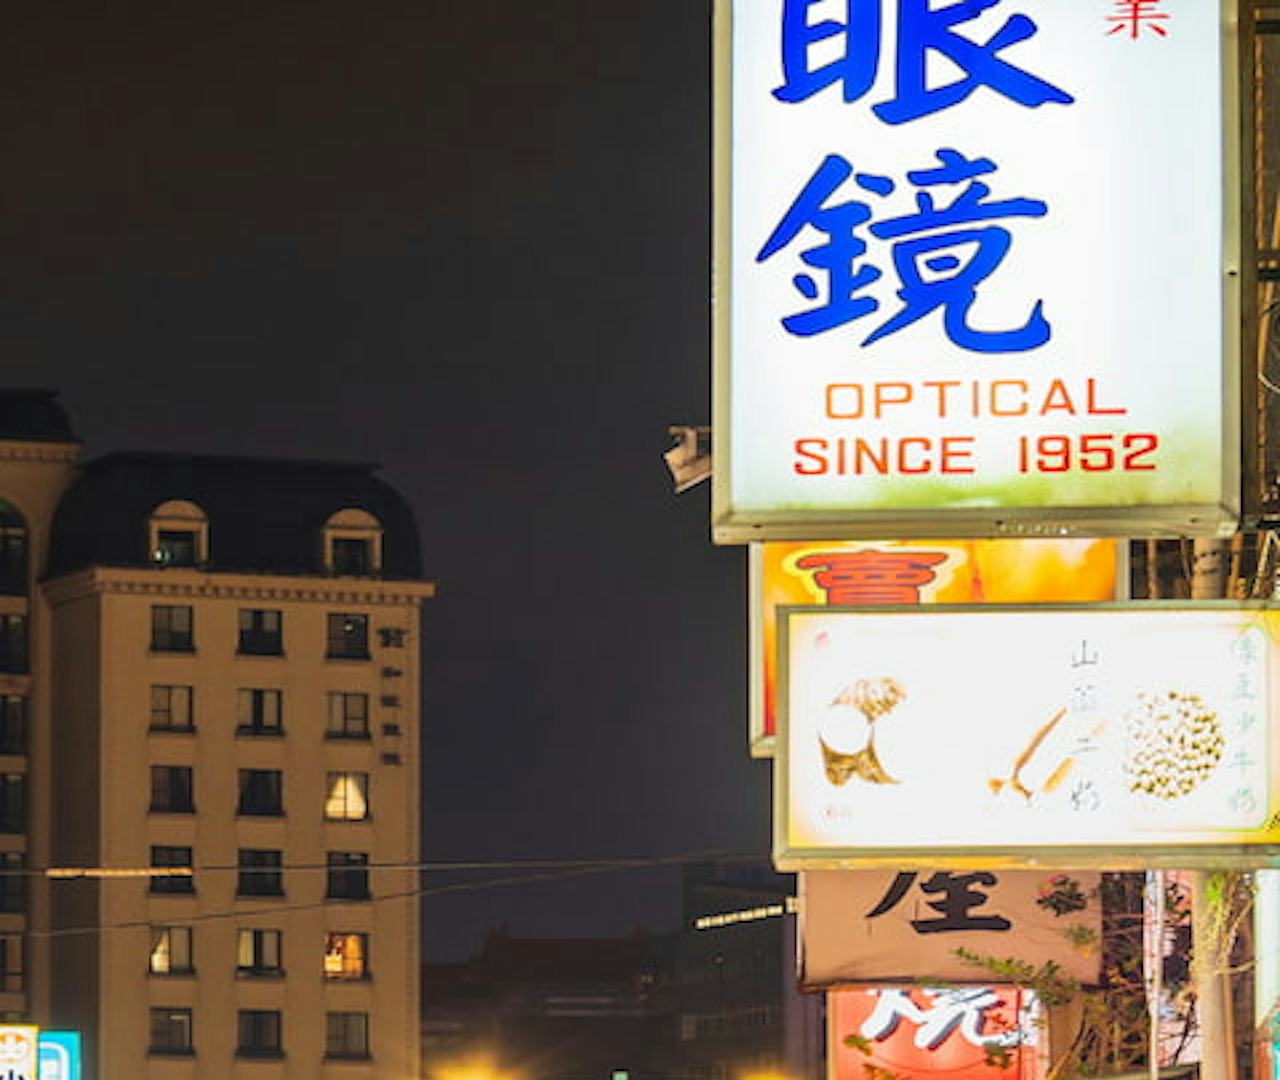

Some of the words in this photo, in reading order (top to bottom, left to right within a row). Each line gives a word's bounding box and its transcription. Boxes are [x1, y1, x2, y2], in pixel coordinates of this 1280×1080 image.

[756, 0, 1076, 354] 眼鏡
[824, 377, 1128, 418] OPTICAL
[793, 436, 976, 476] SINCE
[1019, 433, 1159, 473] 1952
